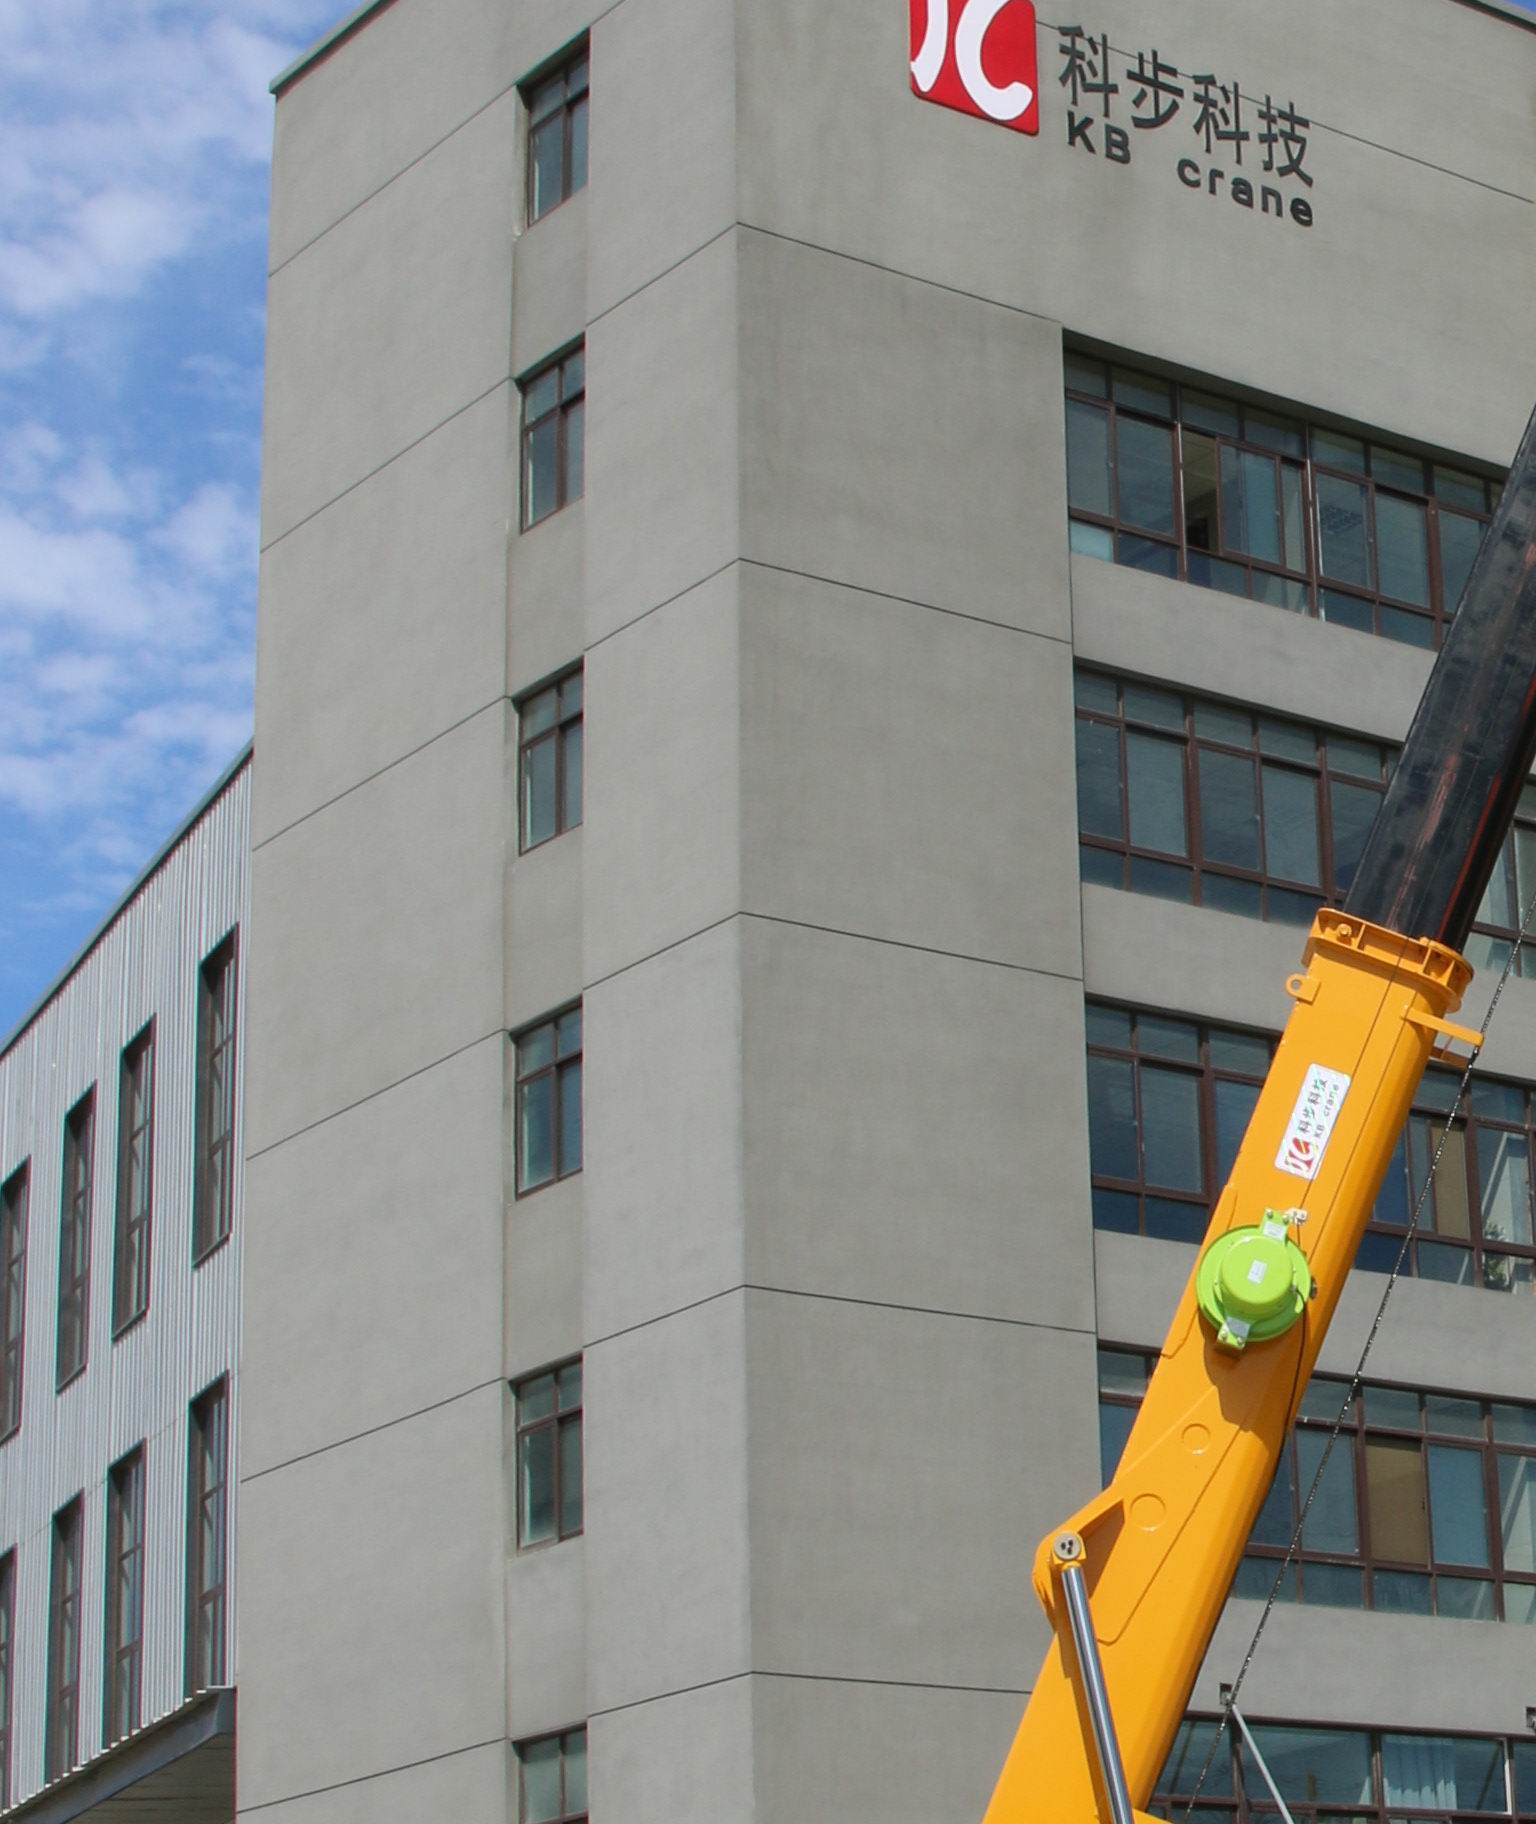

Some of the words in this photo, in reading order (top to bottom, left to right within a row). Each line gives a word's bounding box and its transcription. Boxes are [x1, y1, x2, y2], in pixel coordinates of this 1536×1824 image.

[1058, 25, 1315, 187] 科步科技
[1066, 109, 1132, 165] KB
[1176, 157, 1315, 228] crane
